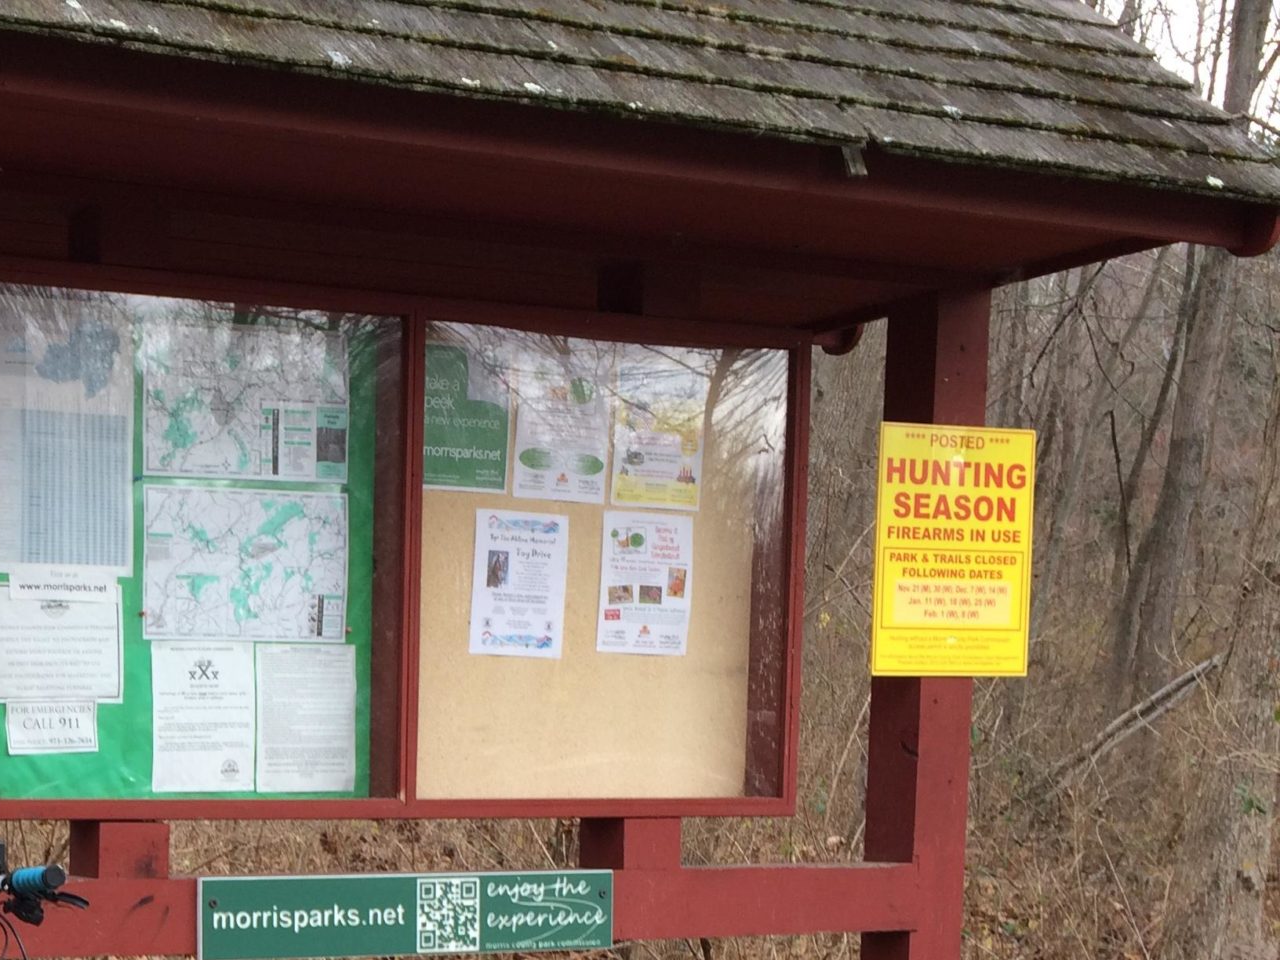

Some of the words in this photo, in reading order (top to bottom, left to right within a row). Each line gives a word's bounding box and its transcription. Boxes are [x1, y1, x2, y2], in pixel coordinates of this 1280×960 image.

[930, 433, 985, 450] POSTED
[886, 457, 1026, 490] HUNTING
[893, 492, 1017, 522] SEASON
[887, 526, 965, 542] FIREARMS
[970, 529, 985, 543] IN
[991, 530, 1021, 544] USE
[889, 552, 918, 563] PARK
[921, 553, 929, 563] &
[933, 554, 971, 565] TRAILS
[975, 555, 1017, 566] CLOSED
[902, 567, 965, 579] FOLLOWING
[970, 569, 1003, 580] DATES
[18, 582, 107, 593] www.morrisparks.net
[23, 717, 54, 730] CALL
[59, 717, 80, 729] 911
[487, 876, 545, 902] enjoy
[554, 876, 591, 897] the
[213, 903, 405, 933] morrisparks.net
[487, 905, 607, 933] experience
